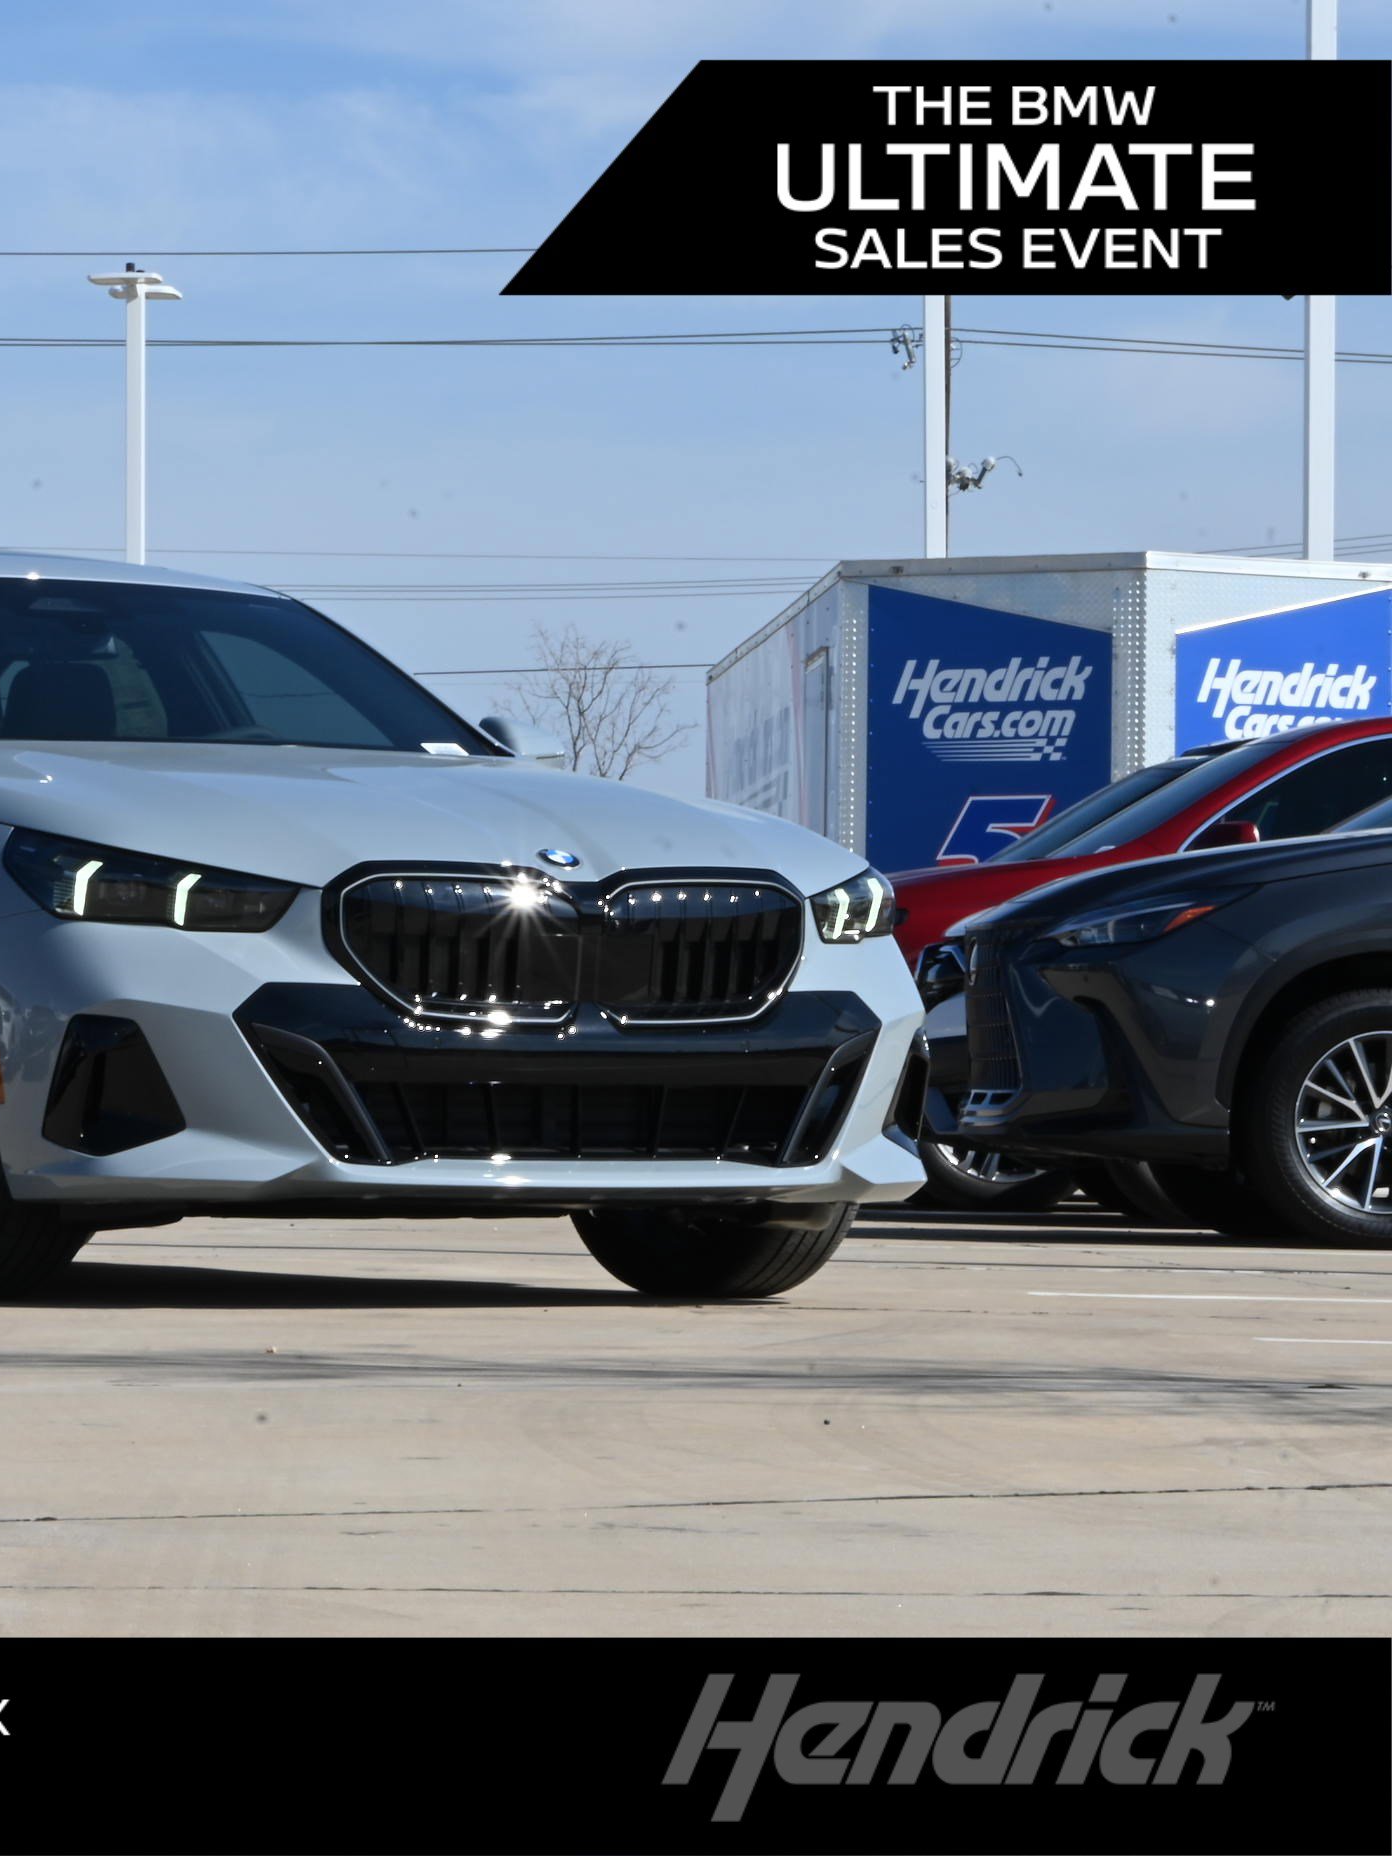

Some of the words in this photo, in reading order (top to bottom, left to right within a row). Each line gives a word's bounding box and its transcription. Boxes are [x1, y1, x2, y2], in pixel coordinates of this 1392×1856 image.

[892, 655, 1093, 719] Hendrick
[1197, 657, 1377, 718] Hendrick
[922, 704, 1076, 739] Cars.com
